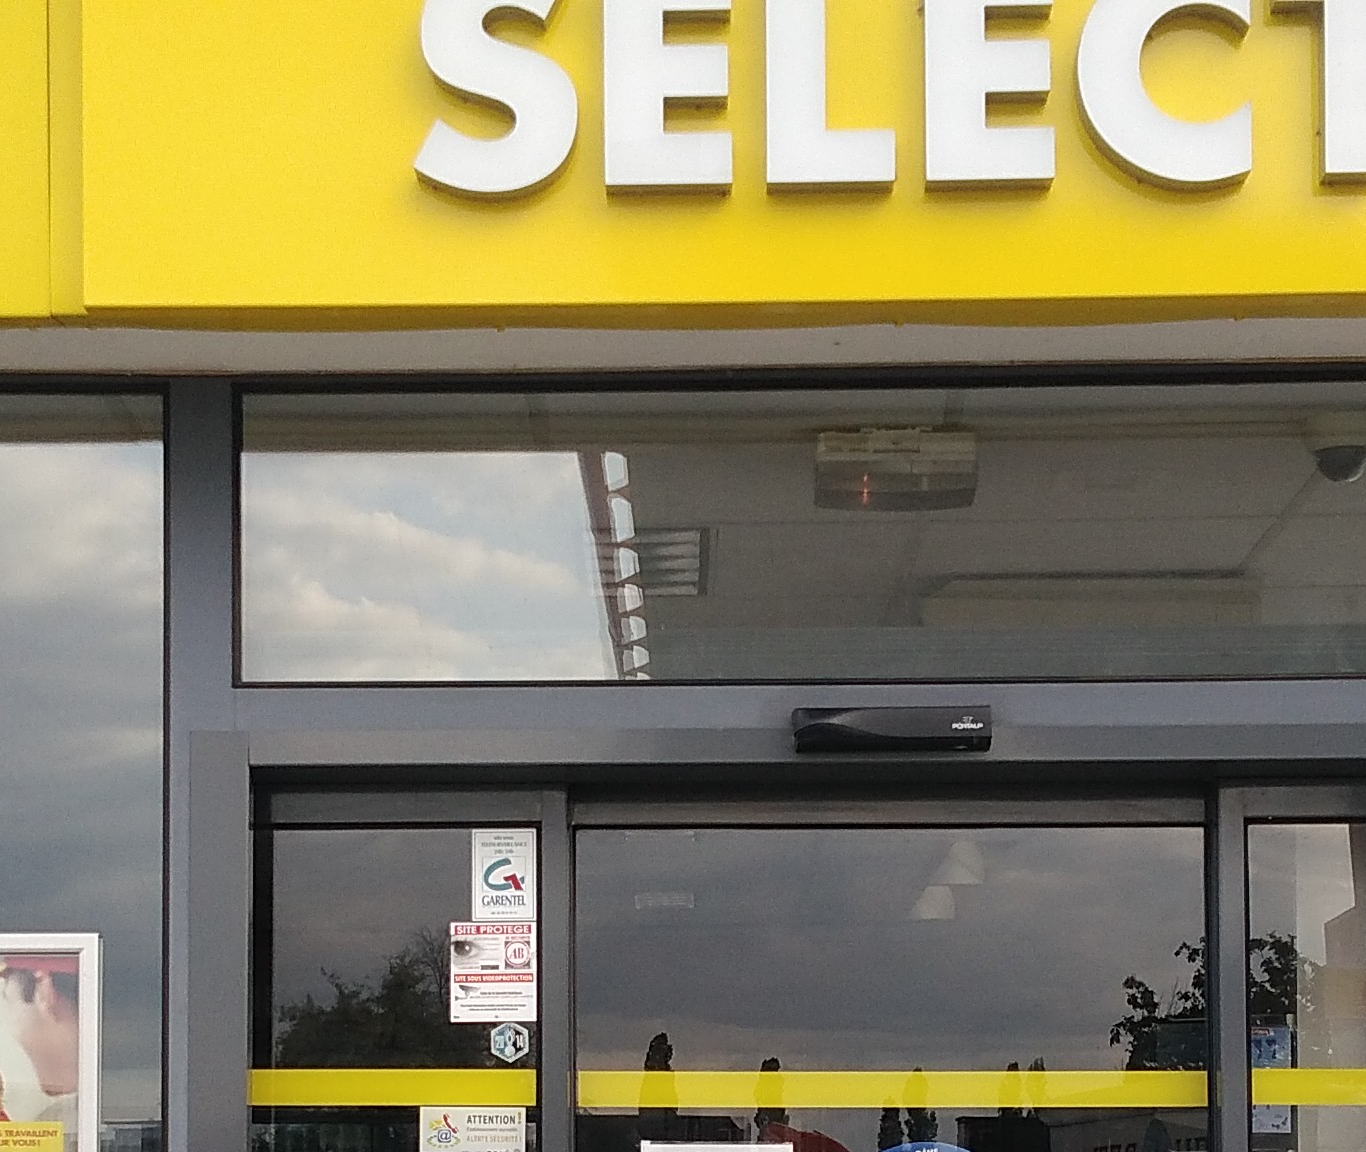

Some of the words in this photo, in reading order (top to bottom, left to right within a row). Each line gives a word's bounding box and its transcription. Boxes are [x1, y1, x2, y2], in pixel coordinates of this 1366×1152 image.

[481, 895, 526, 906] GARENTEL
[456, 925, 478, 935] SITE
[480, 925, 530, 934] PROTEGE
[4, 1130, 58, 1138] TRAVAILLENT
